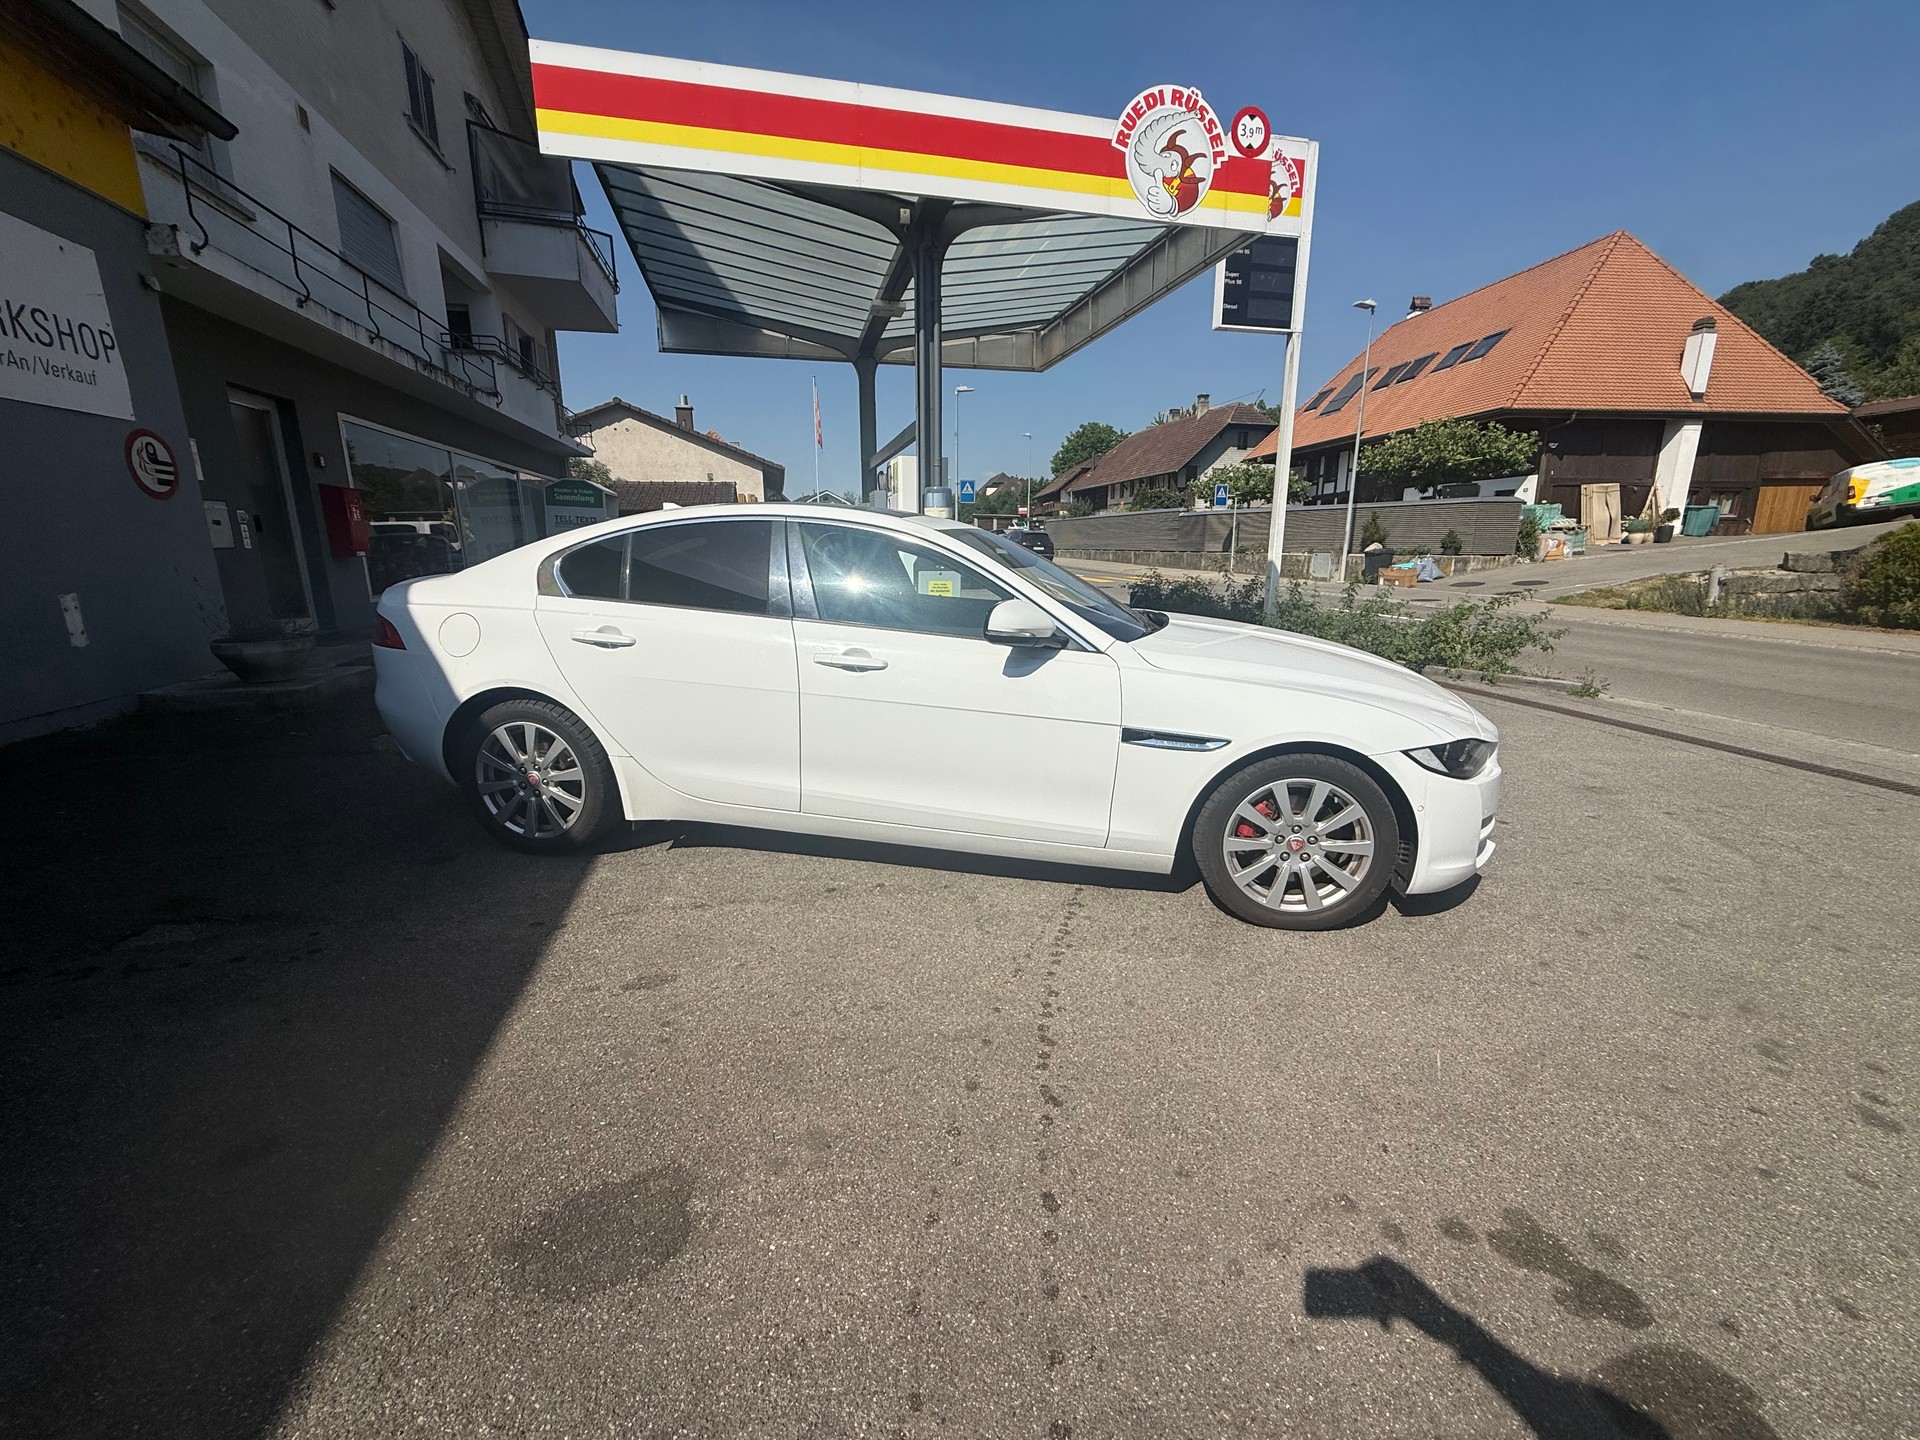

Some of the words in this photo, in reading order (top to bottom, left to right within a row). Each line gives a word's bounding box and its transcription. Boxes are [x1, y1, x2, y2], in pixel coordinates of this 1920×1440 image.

[1115, 89, 1166, 149] RUEDI
[1170, 88, 1225, 165] RÜSSEL
[1272, 148, 1298, 190] ÜSSEL
[553, 493, 595, 503] Sammlung
